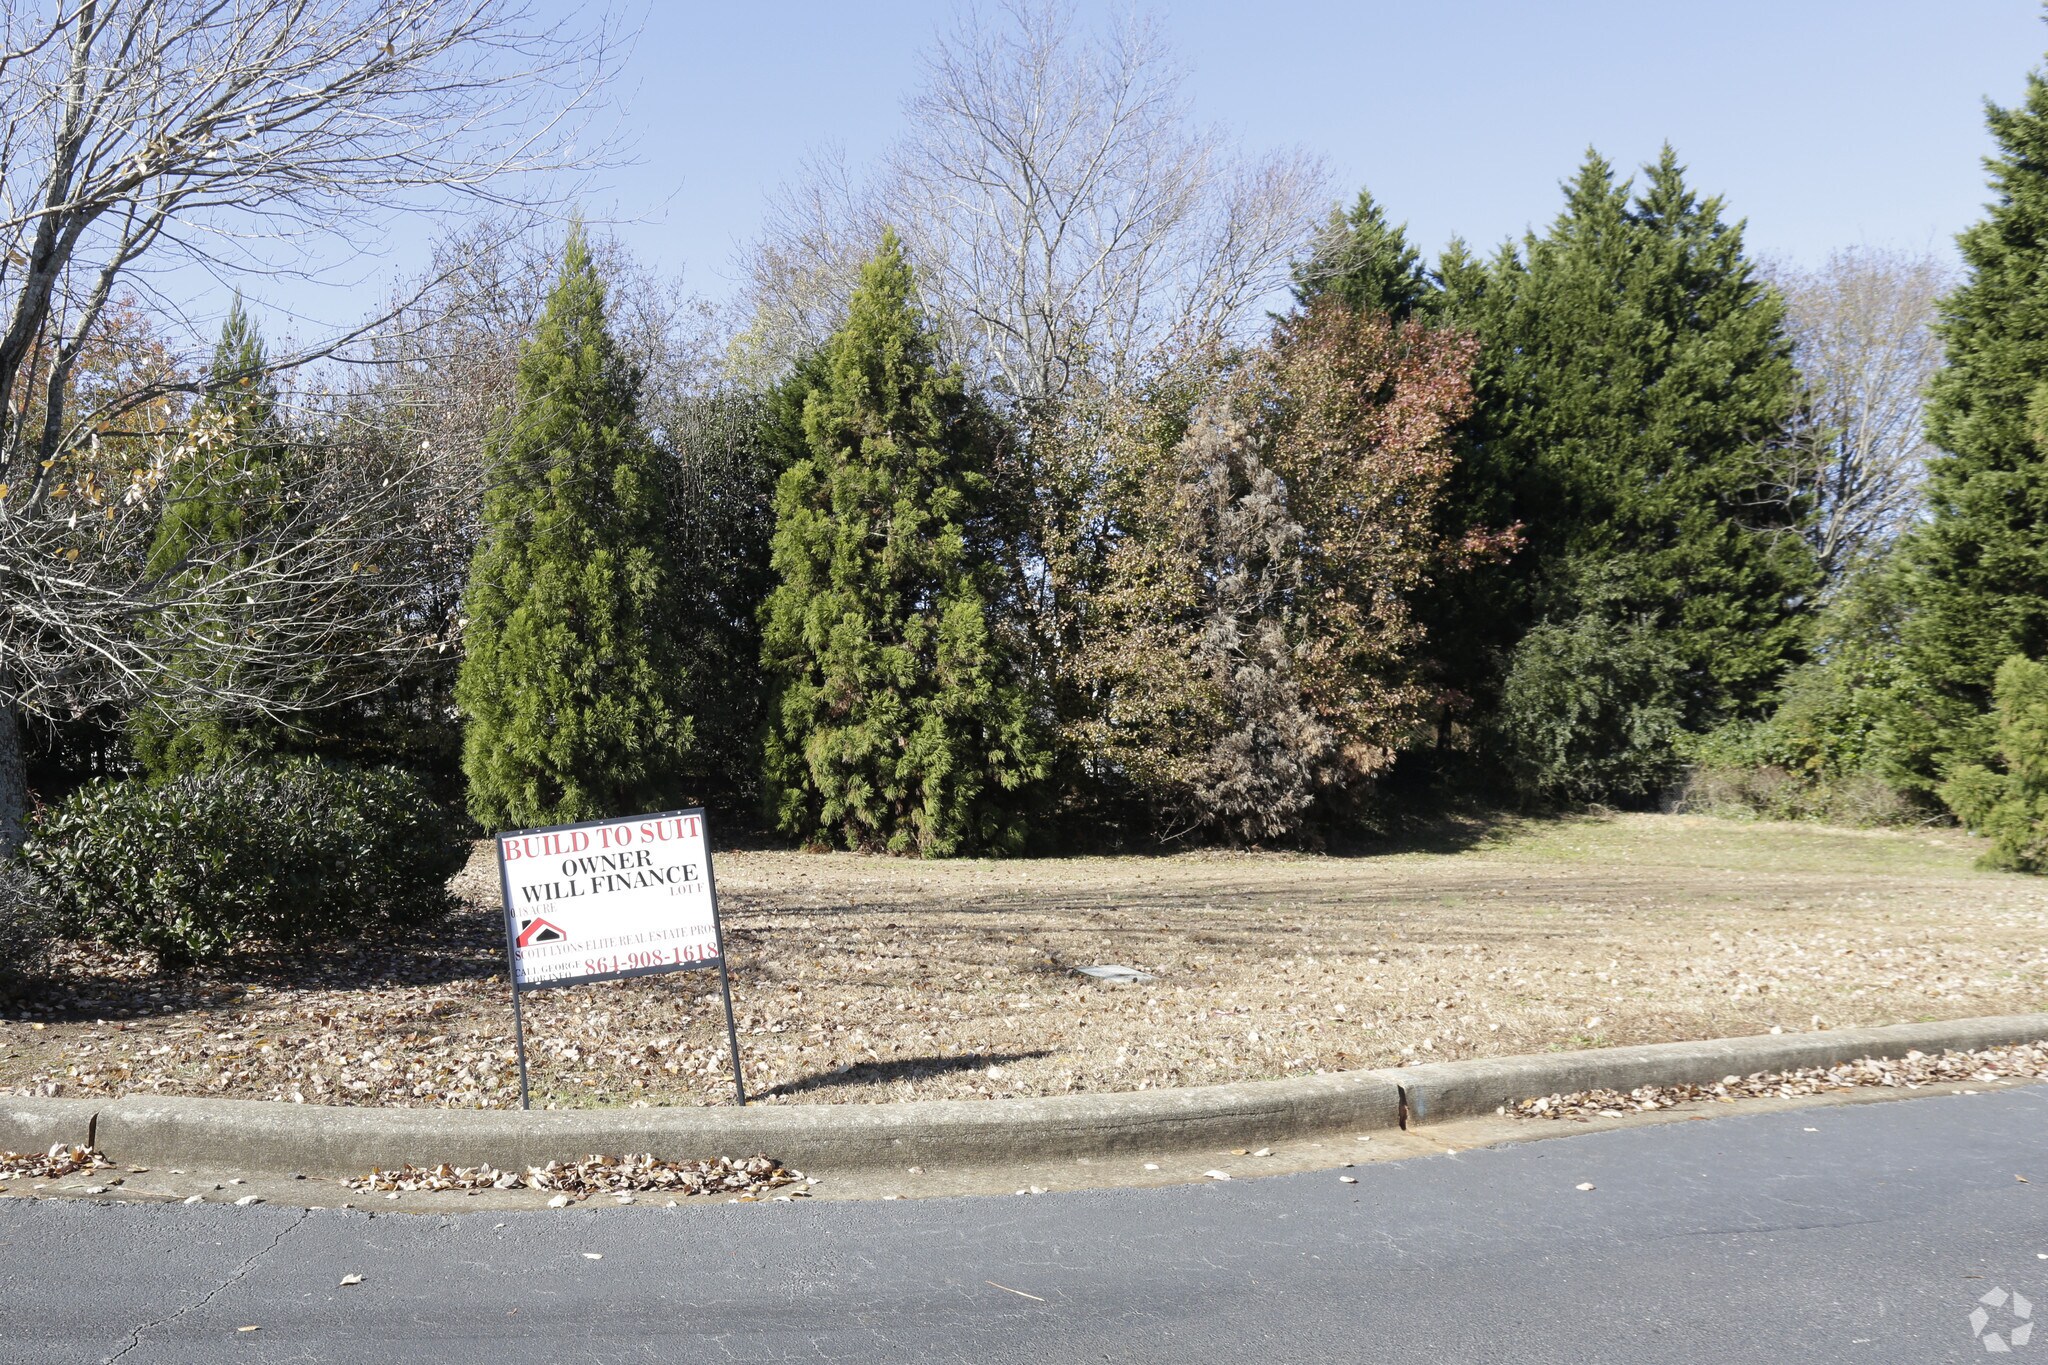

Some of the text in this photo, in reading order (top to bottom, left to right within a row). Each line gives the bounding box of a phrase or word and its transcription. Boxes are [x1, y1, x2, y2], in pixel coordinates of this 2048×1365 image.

[503, 816, 701, 862] BUILD TO SUIT
[562, 849, 653, 877] OWNER
[521, 863, 699, 903] WILL FINANCE
[670, 883, 694, 896] LOT
[530, 902, 557, 915] ACRE
[514, 946, 548, 960] SCOTT
[550, 943, 583, 956] LYONS
[585, 938, 616, 951] ELITE
[619, 933, 648, 946] REAL
[648, 927, 687, 942] ESTATE
[515, 941, 719, 978] CALL GEORGE 864-908-1618
